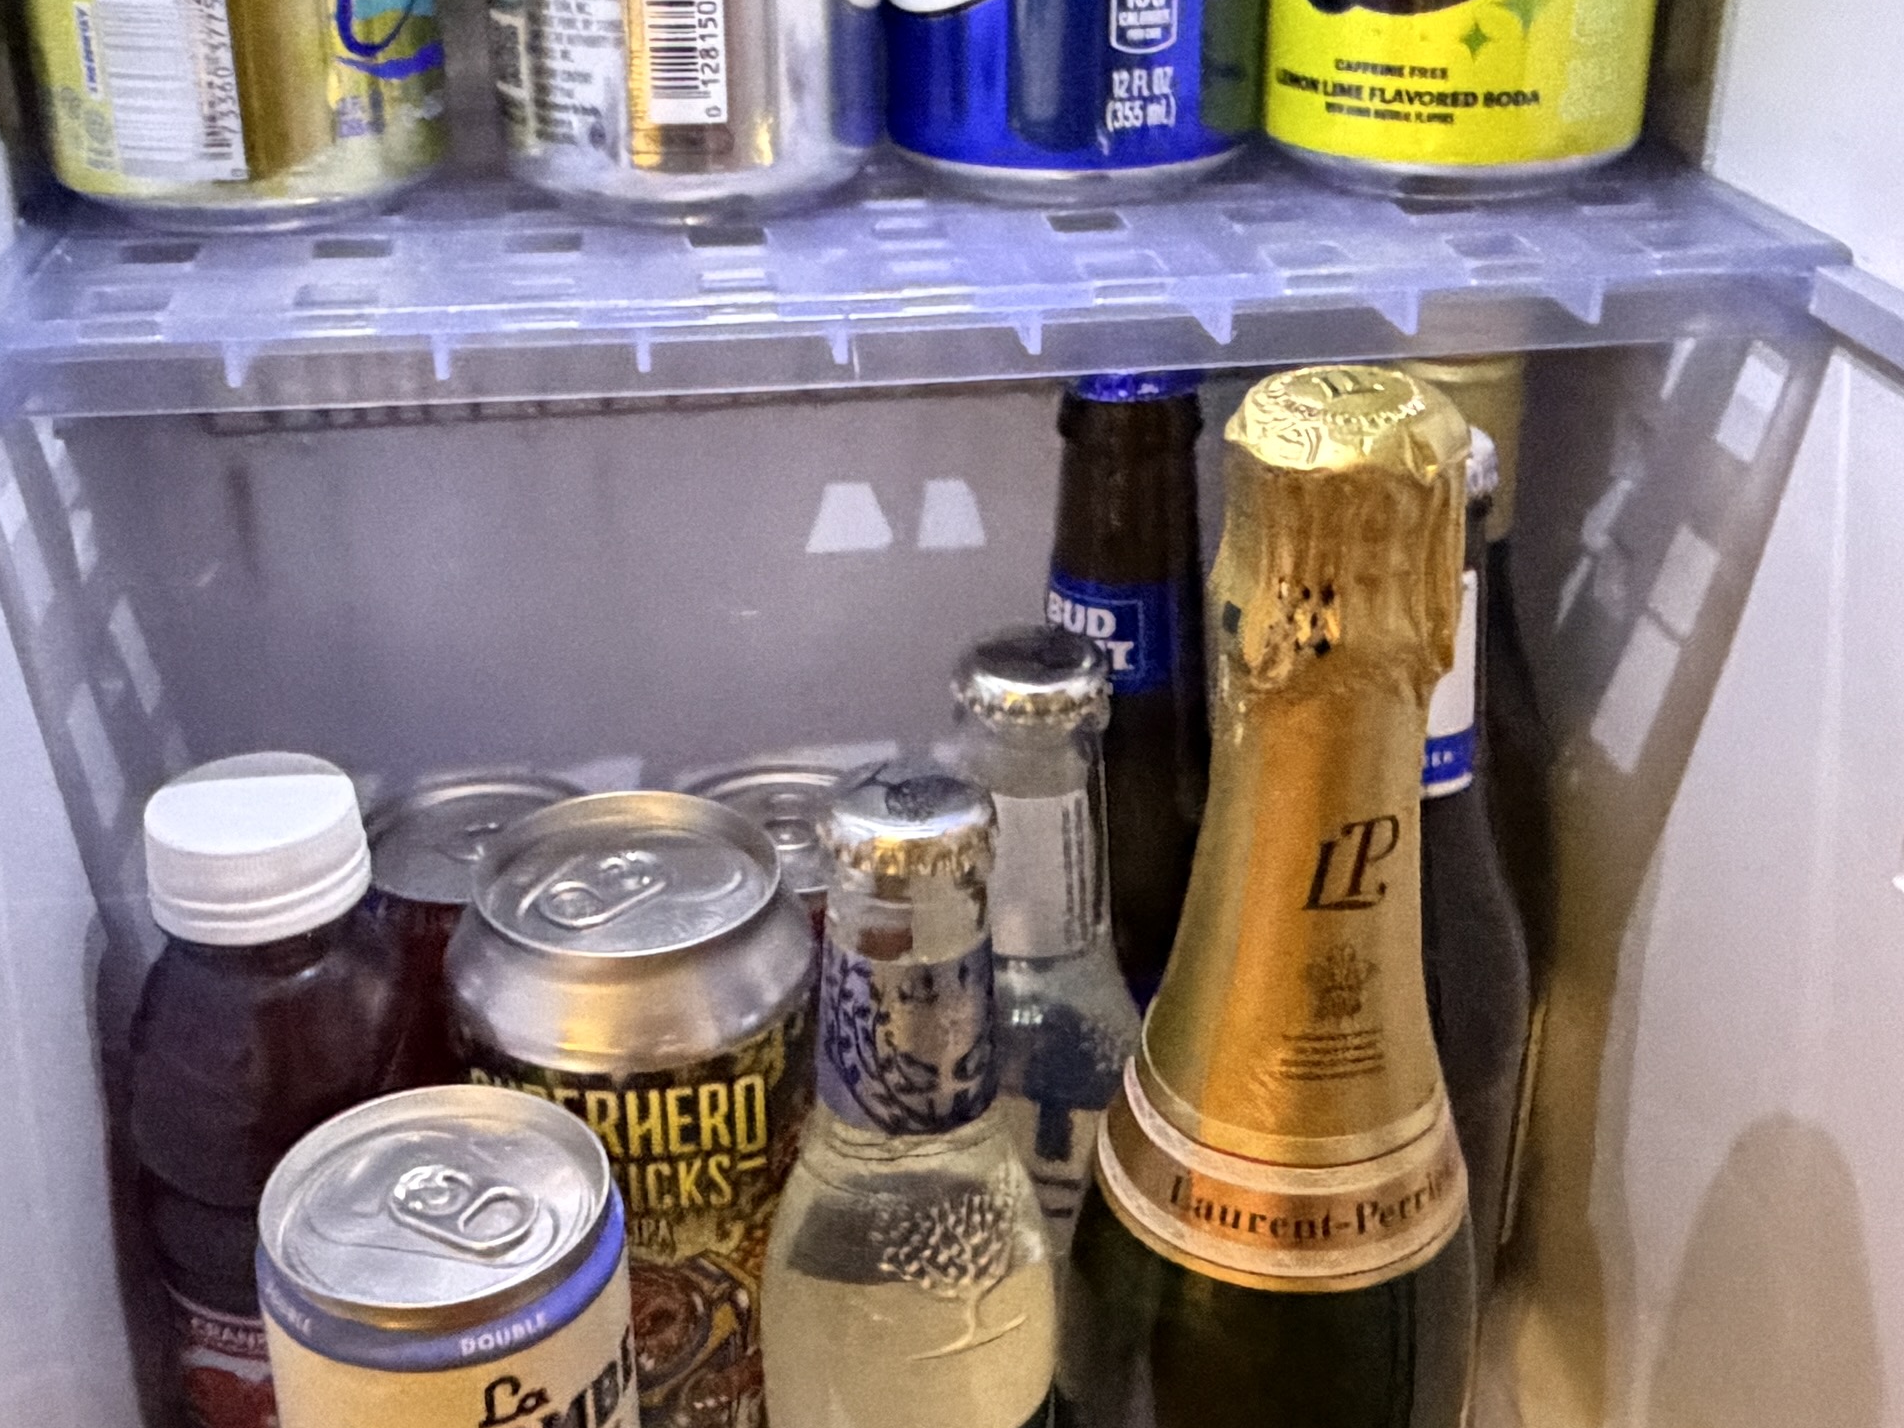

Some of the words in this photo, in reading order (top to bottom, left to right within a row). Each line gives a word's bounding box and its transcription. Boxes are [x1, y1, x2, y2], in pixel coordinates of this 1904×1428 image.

[696, 0, 720, 88] 128150
[1112, 69, 1130, 99] 12
[1323, 79, 1364, 101] LIME
[1368, 86, 1478, 108] FLAVORED
[1046, 590, 1117, 639] BUD
[470, 1068, 767, 1159] RHERO
[613, 1153, 732, 1213] ICKS
[458, 1313, 548, 1358] DOUBLE
